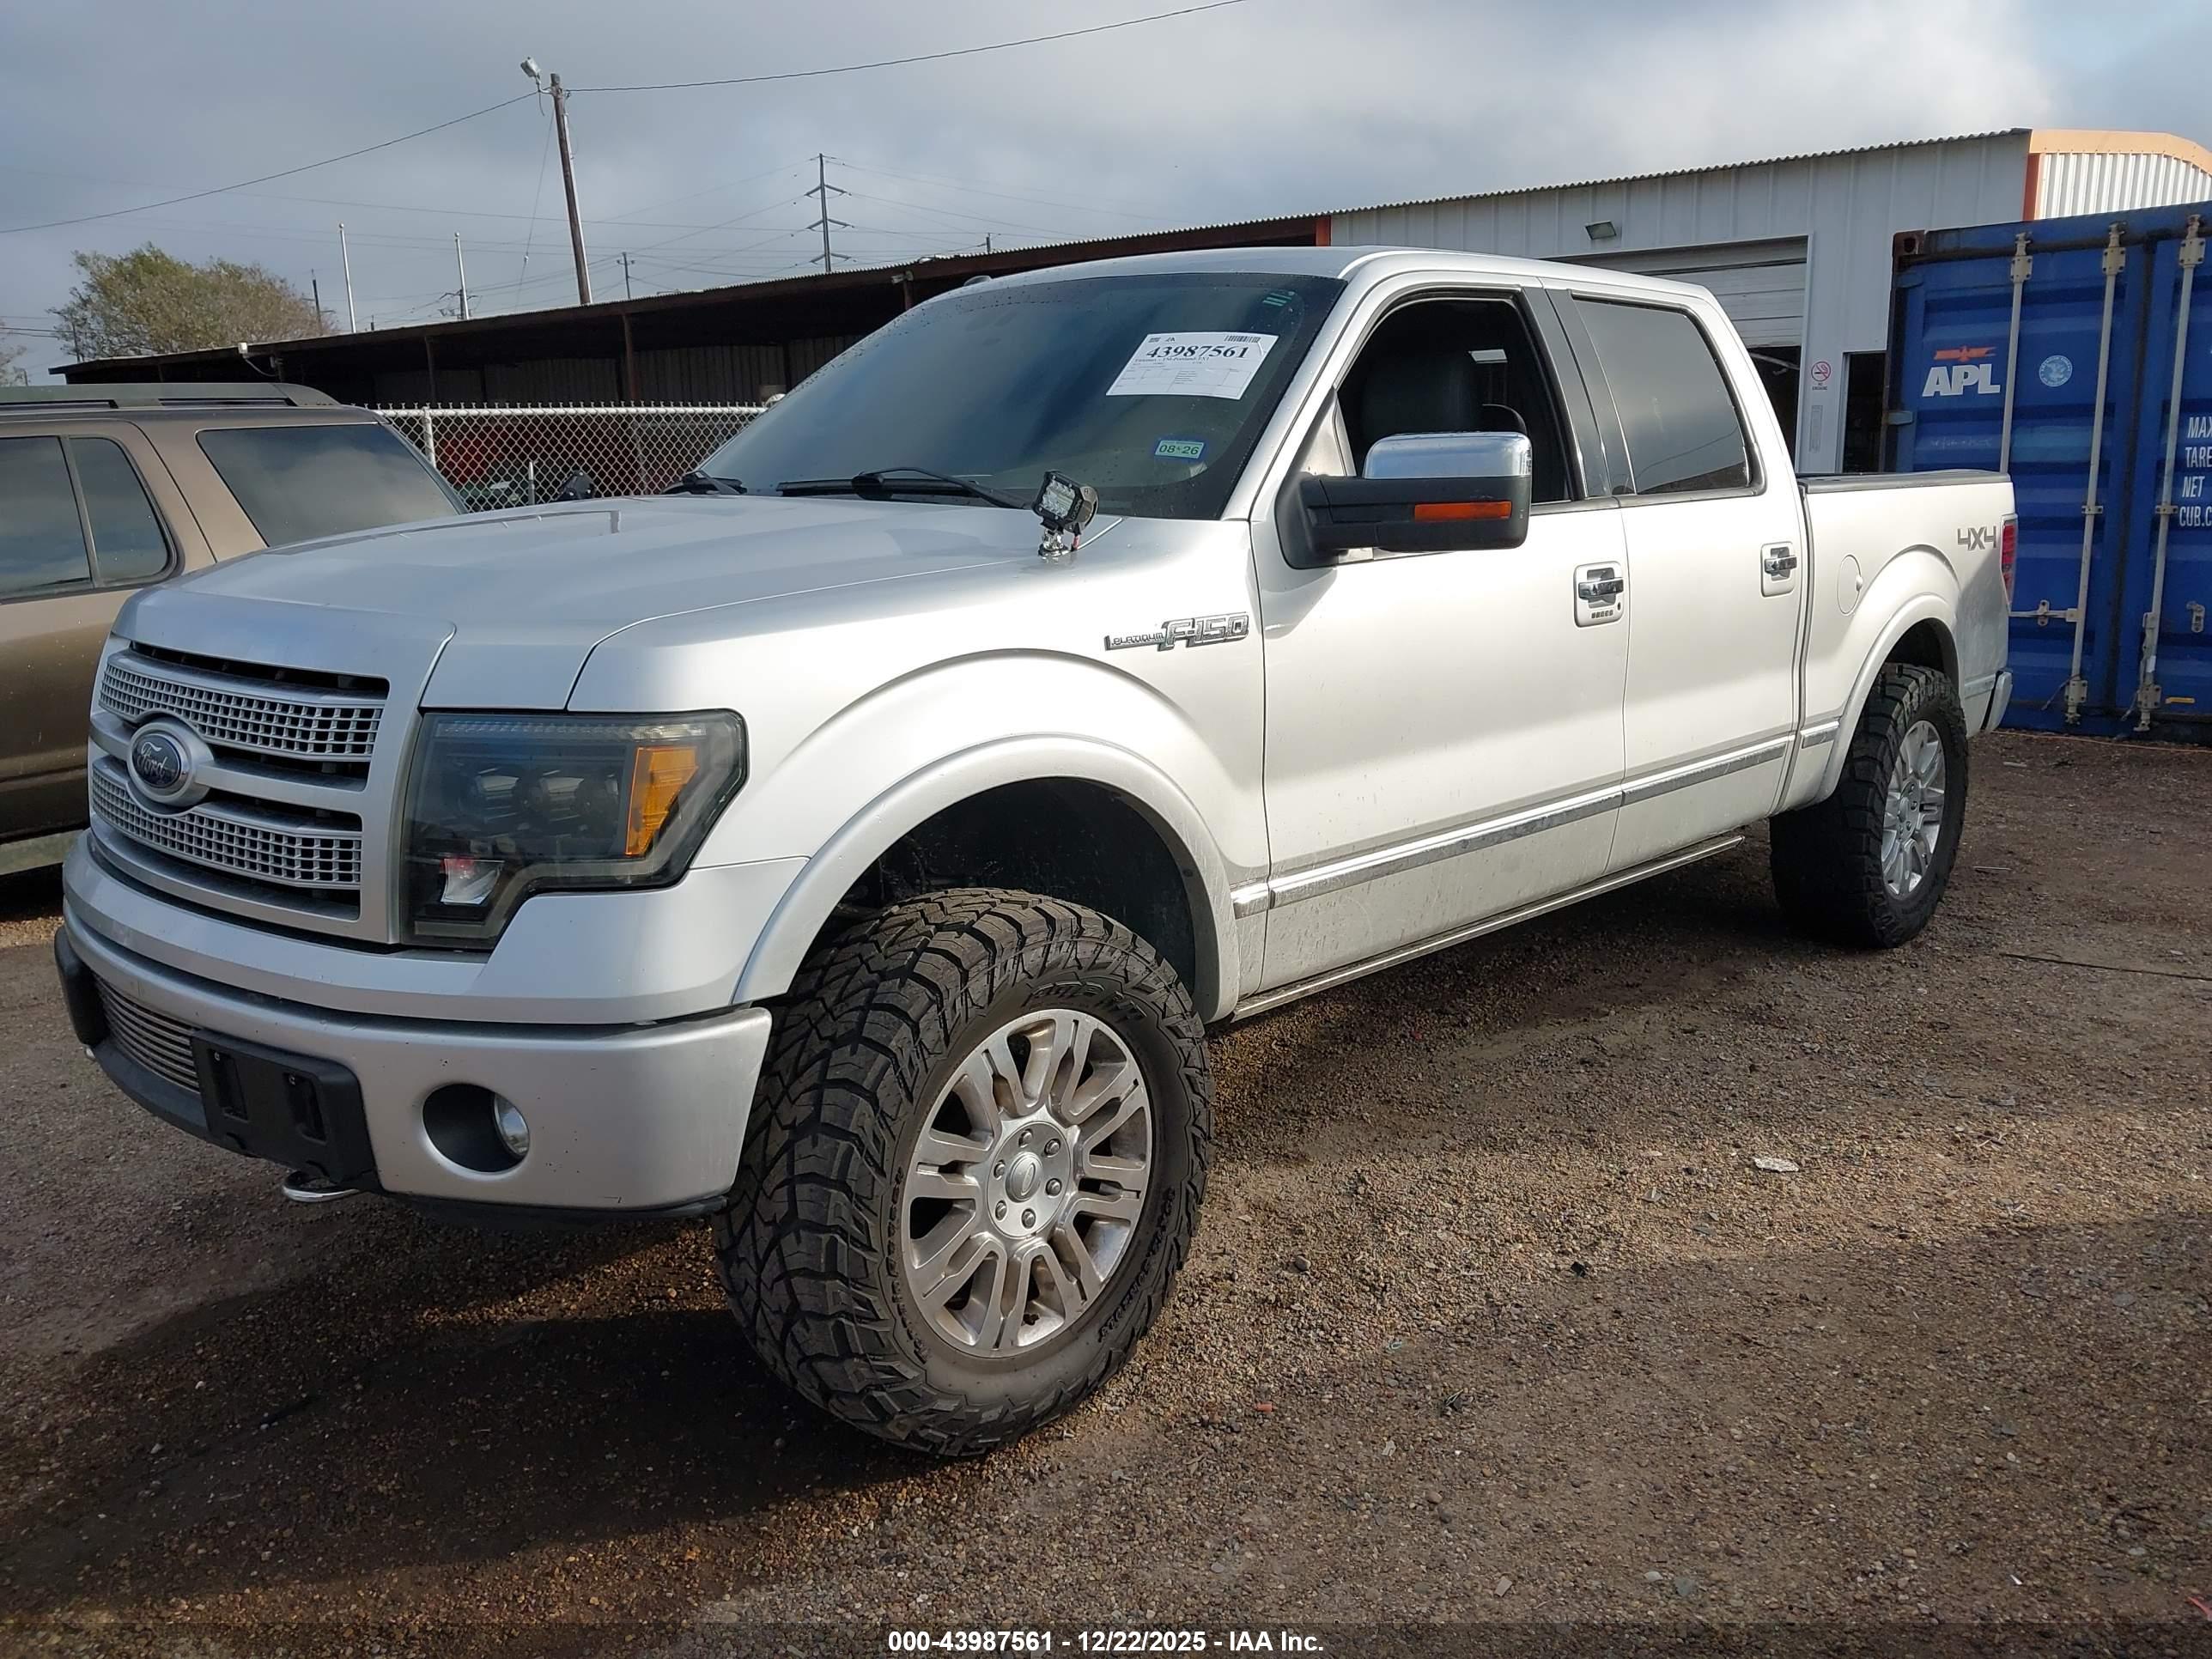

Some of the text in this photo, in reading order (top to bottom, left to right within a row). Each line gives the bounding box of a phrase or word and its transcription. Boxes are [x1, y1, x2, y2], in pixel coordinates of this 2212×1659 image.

[1146, 344, 1249, 359] 43987561
[1922, 363, 2001, 398] APL
[2185, 447, 2212, 468] TARE
[2181, 476, 2205, 498] NET
[1957, 526, 1996, 550] 4X4
[1112, 611, 1249, 651] PLATINUM F-150
[138, 741, 170, 778] Ford
